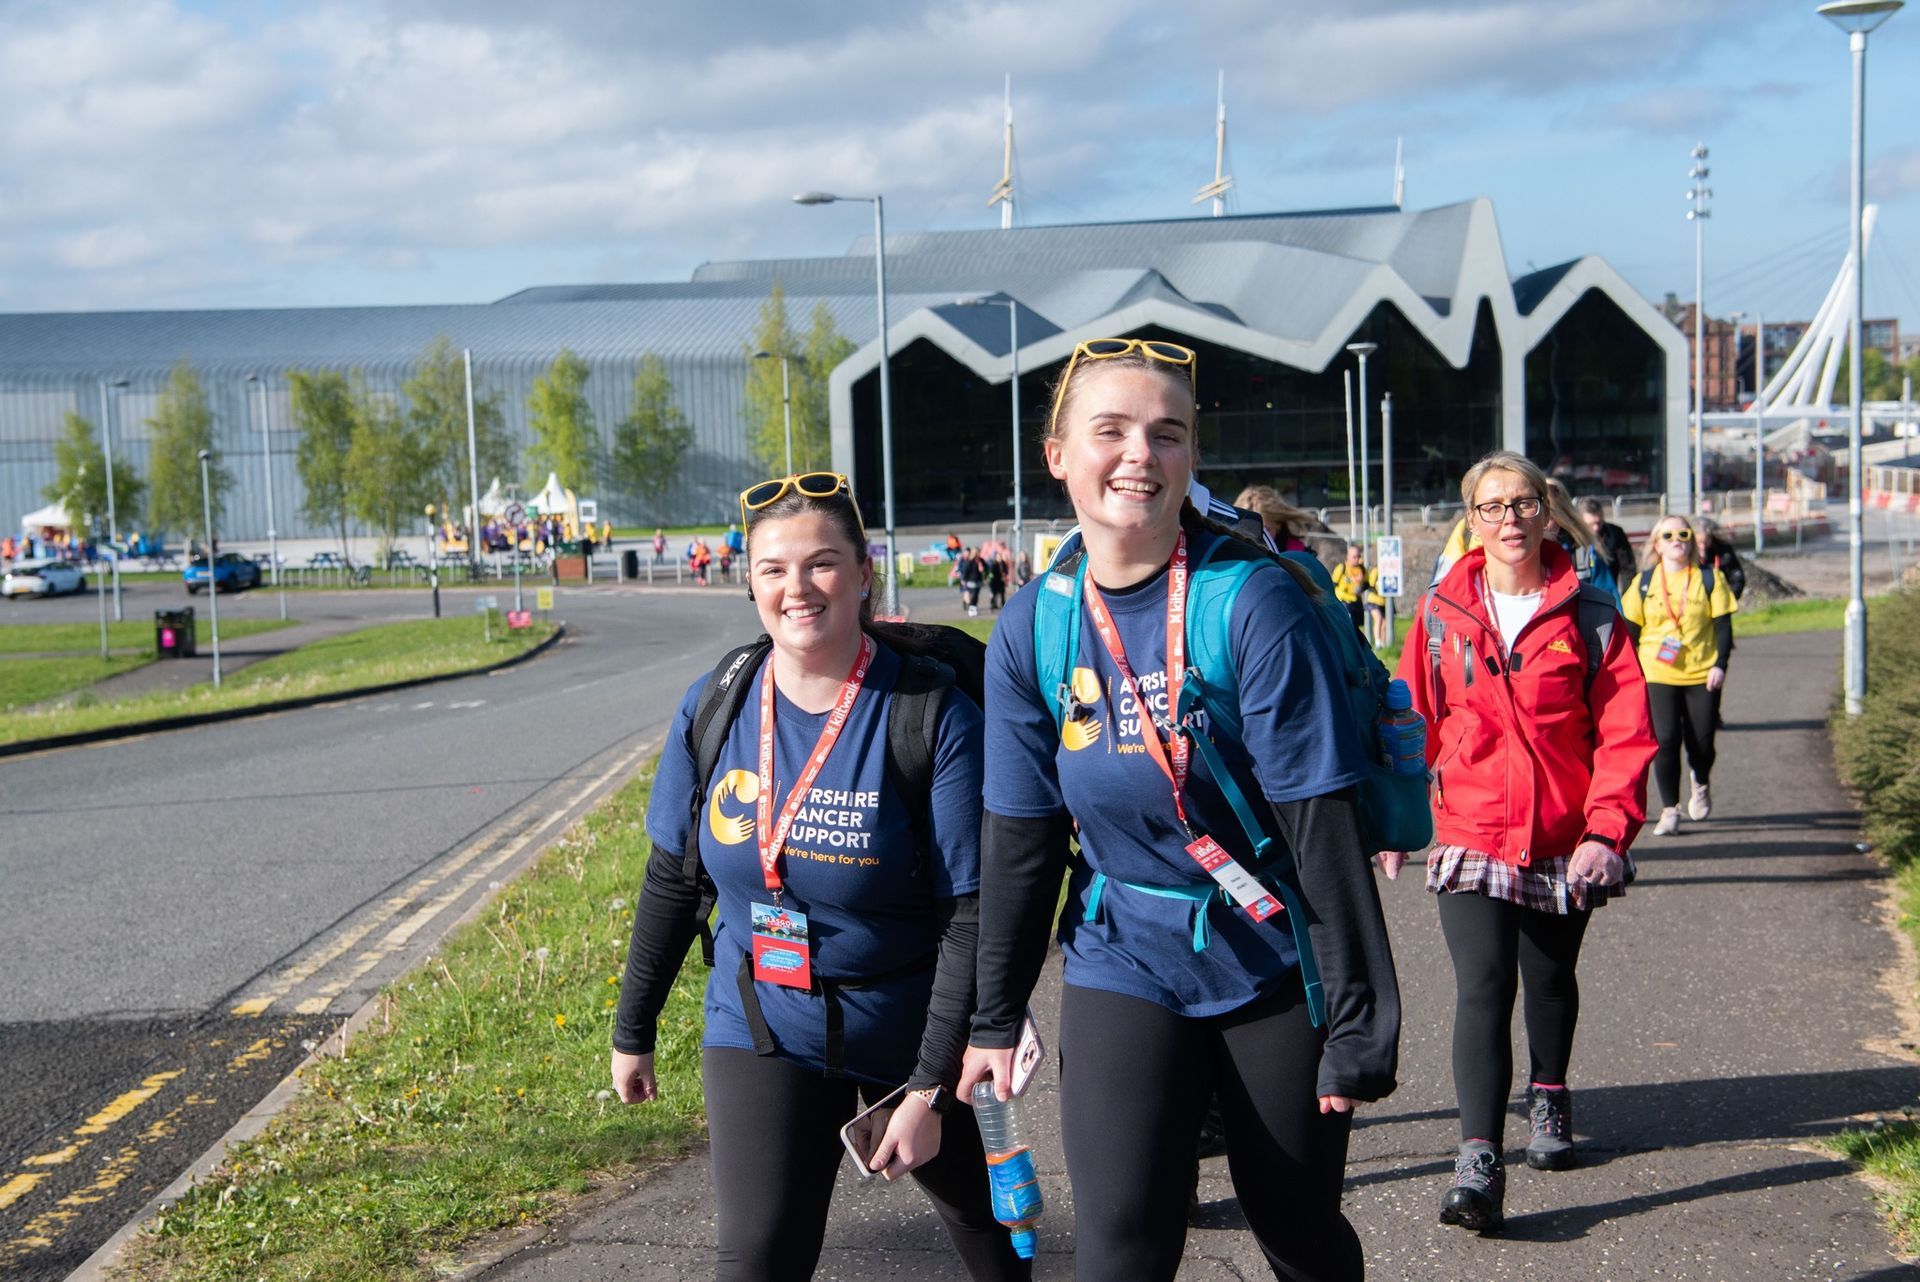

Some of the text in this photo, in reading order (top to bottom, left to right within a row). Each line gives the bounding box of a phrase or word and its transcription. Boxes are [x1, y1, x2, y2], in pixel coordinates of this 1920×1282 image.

[1170, 561, 1187, 613] kiltwalk
[719, 653, 750, 687] DLX
[829, 680, 860, 727] kiltwalk
[759, 743, 772, 791] kiltwalk
[795, 806, 863, 828] ANCER
[766, 813, 793, 863] kiltwalk
[787, 824, 871, 849] UPPORT
[810, 850, 836, 864] here
[838, 854, 856, 865] for
[858, 857, 880, 867] you
[761, 915, 799, 928] GLASGOW
